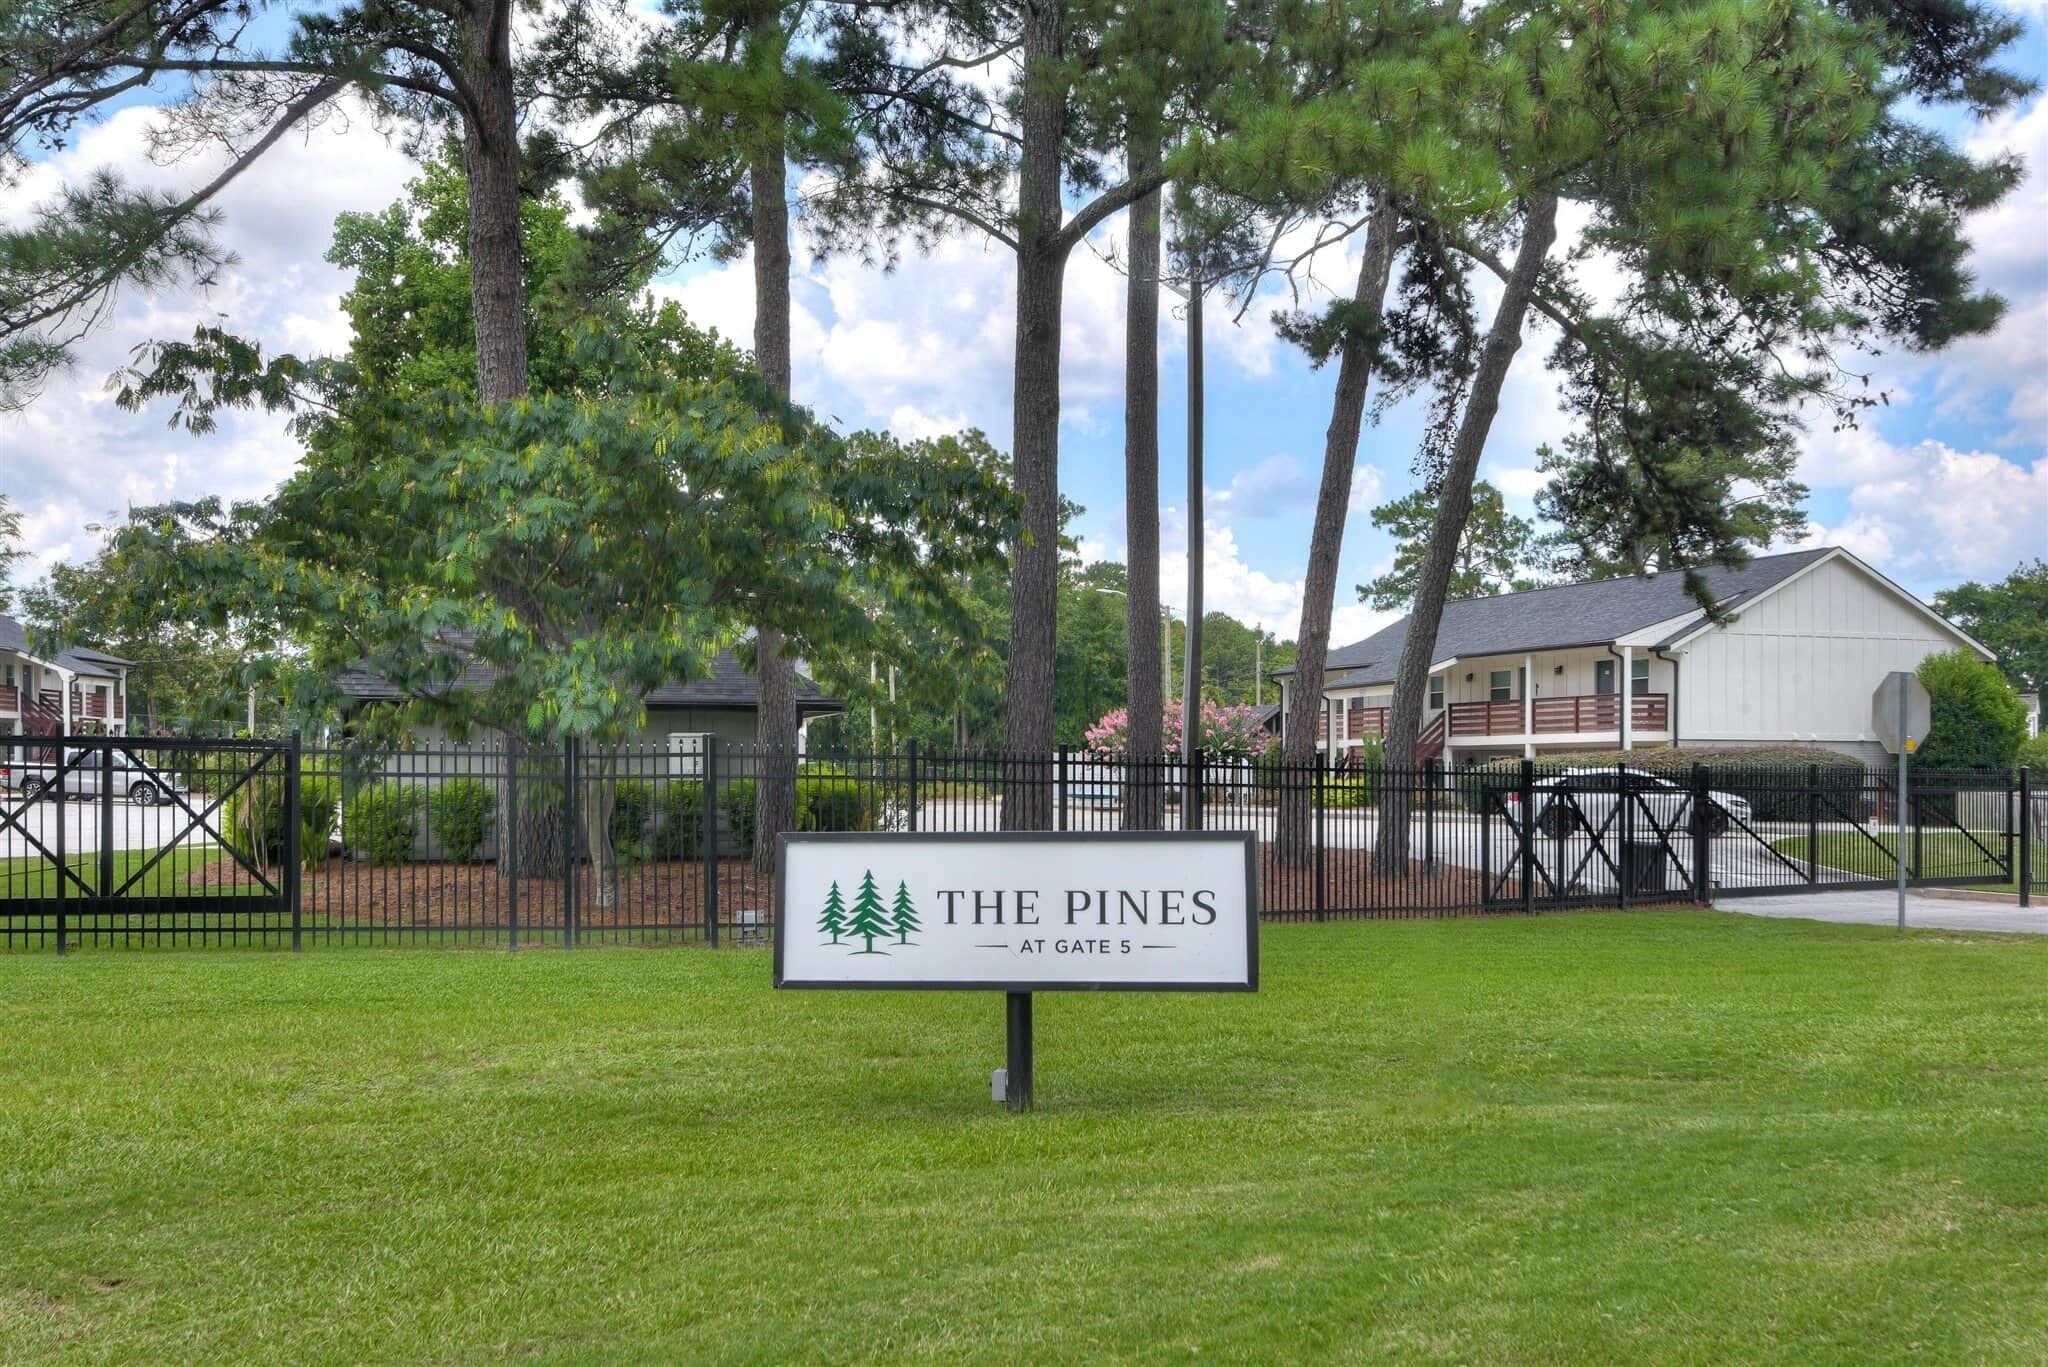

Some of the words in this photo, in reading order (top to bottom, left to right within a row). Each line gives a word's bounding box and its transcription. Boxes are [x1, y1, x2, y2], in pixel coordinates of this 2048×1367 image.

[936, 890, 1040, 925] THE
[1064, 889, 1217, 926] PINES
[1019, 939, 1046, 954] AT
[1055, 939, 1111, 954] GATE
[1120, 939, 1131, 954] 5
